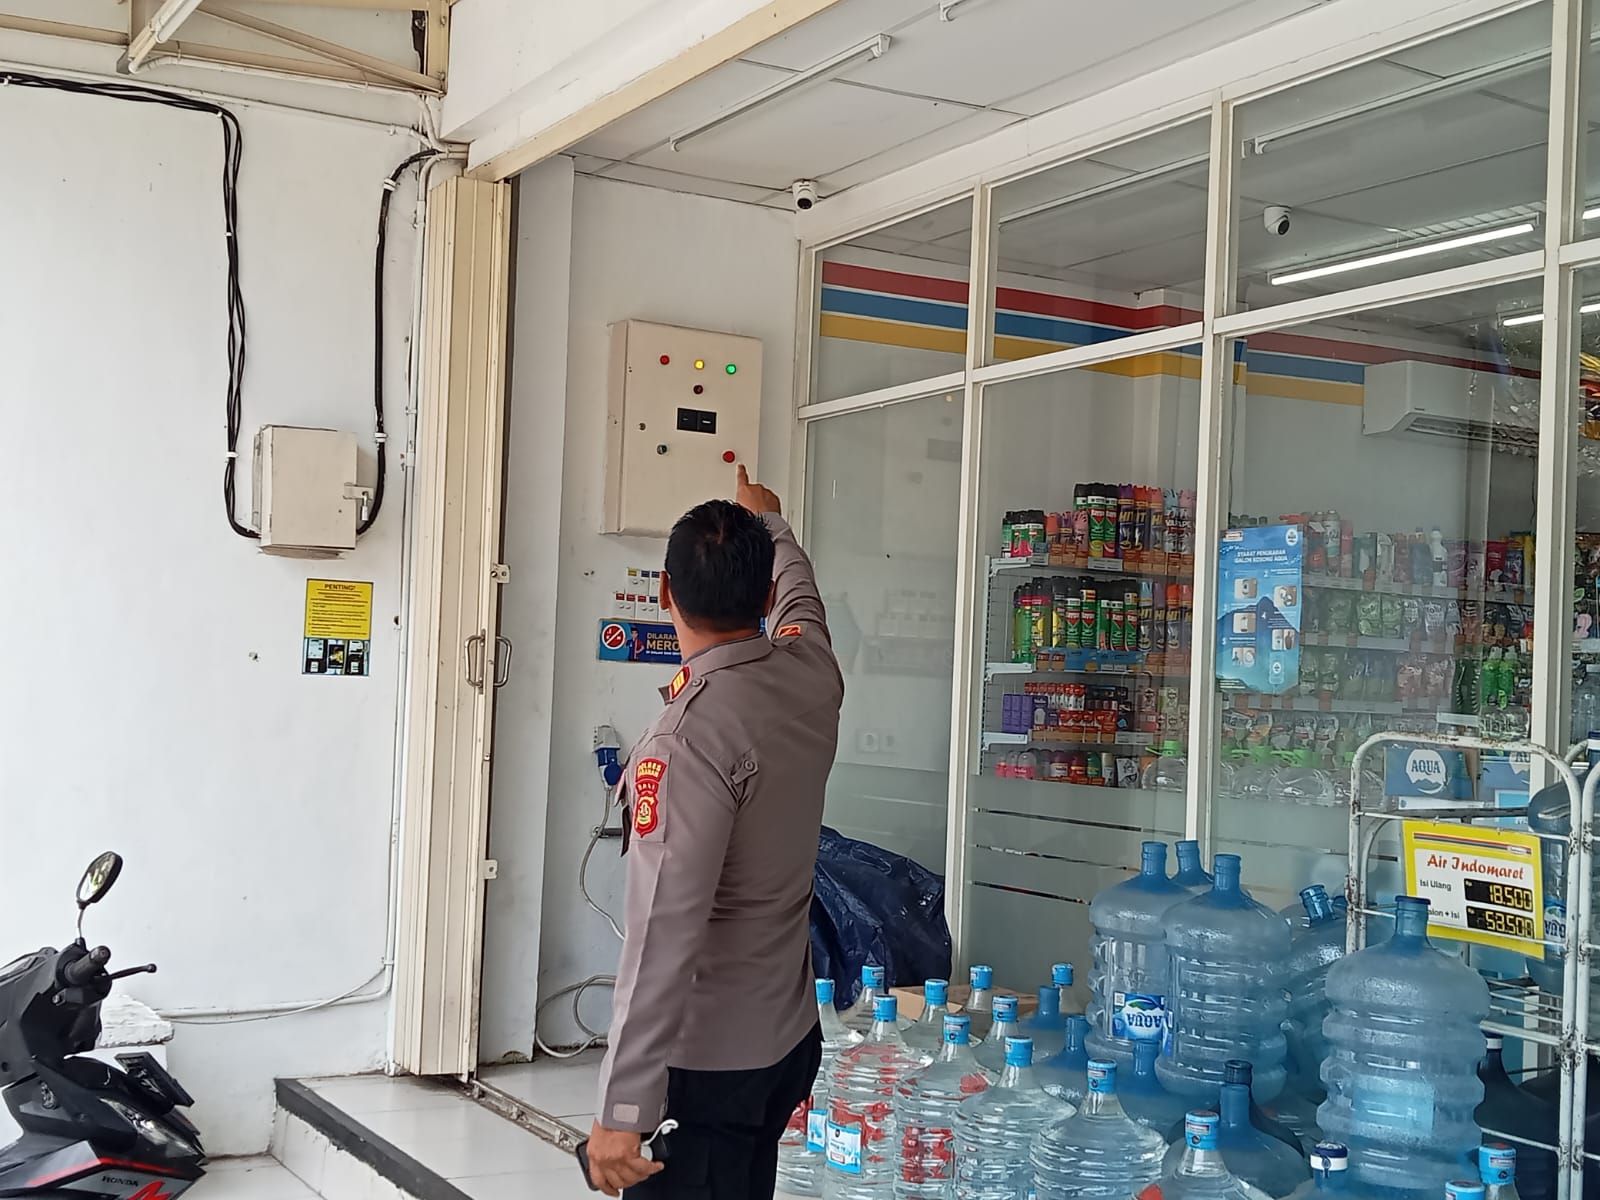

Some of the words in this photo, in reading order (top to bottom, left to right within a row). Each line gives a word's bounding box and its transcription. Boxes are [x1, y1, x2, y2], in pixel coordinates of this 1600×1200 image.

[1154, 609, 1165, 620] HI
[646, 640, 680, 651] MERO
[1411, 760, 1441, 775] AQUA
[1427, 854, 1447, 869] Air
[1451, 857, 1524, 880] Indomaret
[1430, 880, 1452, 891] Ulang
[1489, 885, 1532, 910] 18.500
[1428, 908, 1443, 917] alon
[1451, 911, 1460, 919] Isi
[102, 1176, 139, 1187] HONDA
